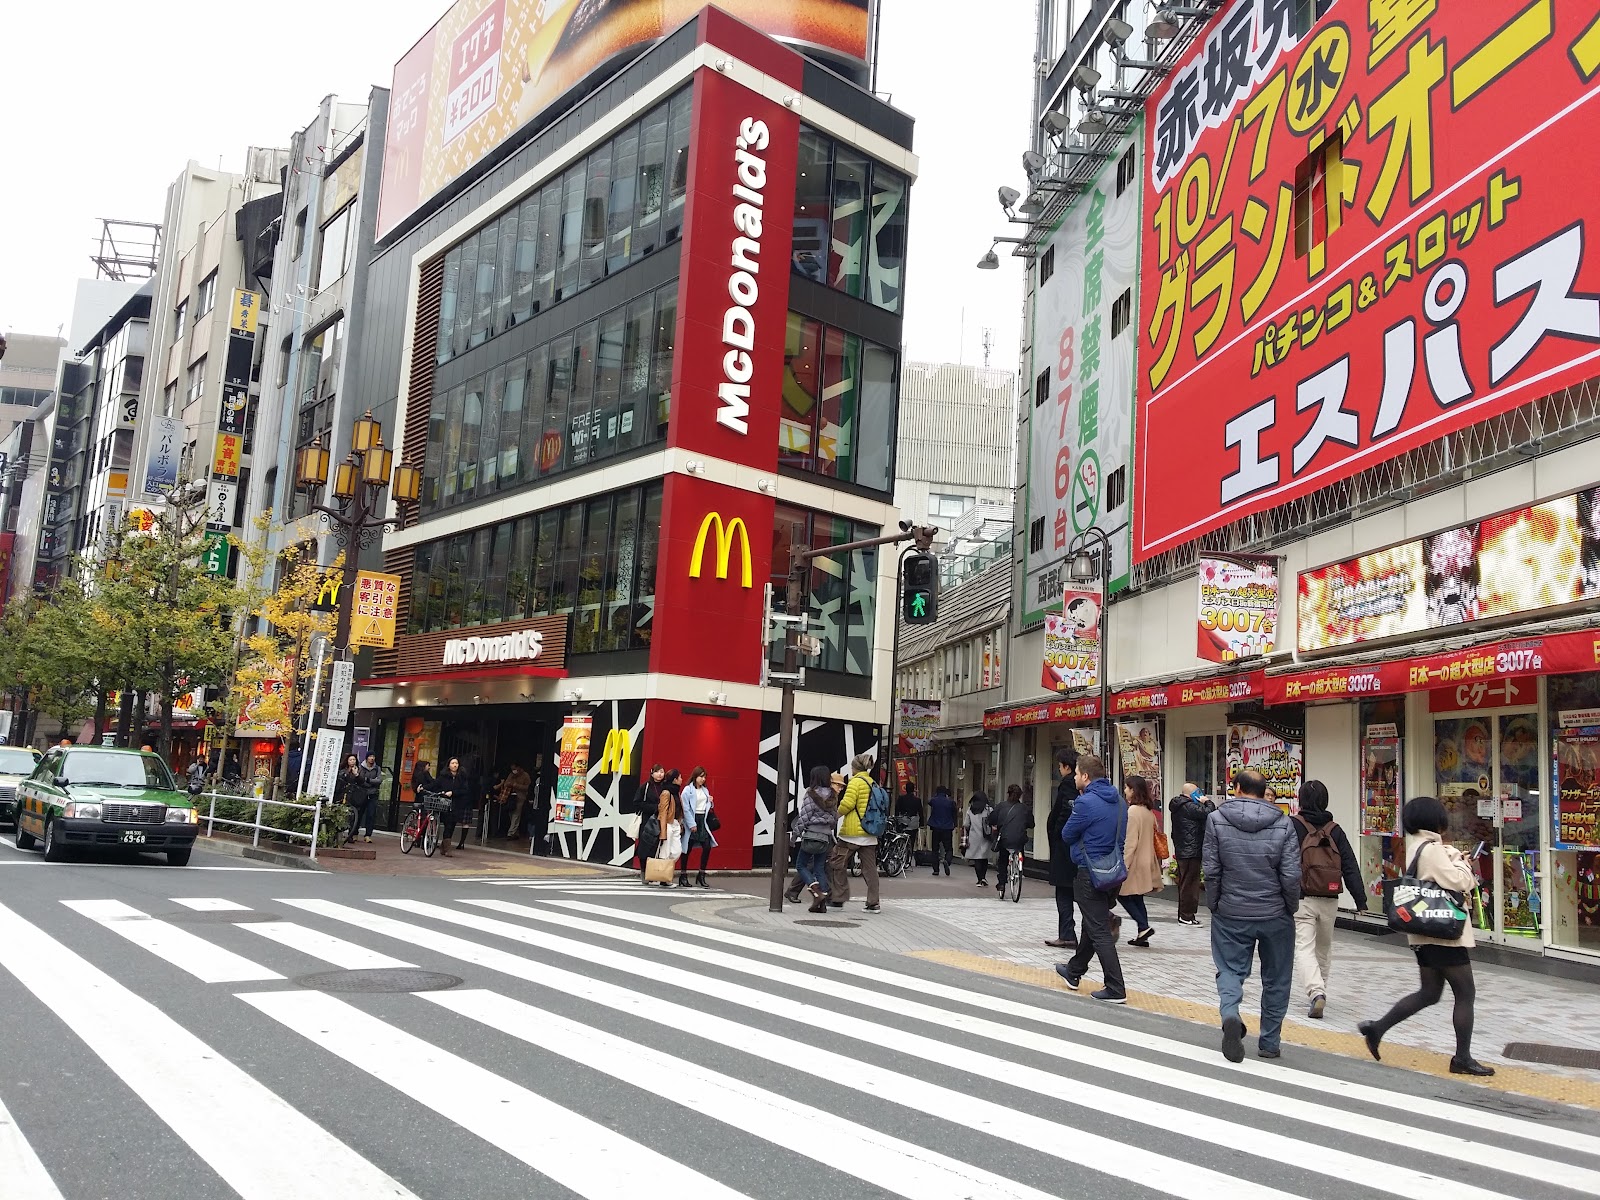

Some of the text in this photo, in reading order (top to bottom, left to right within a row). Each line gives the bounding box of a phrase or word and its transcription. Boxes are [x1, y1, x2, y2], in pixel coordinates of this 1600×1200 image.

[458, 13, 495, 75] エグチ
[450, 66, 494, 127] ¥200
[1152, 68, 1288, 270] 10/7
[716, 116, 770, 435] McDonald's
[1220, 220, 1600, 506] エスパス
[572, 409, 601, 430] FREE
[571, 425, 600, 446] Wi-Fi
[157, 434, 173, 478] バルボラ
[359, 591, 394, 606] 客引き
[360, 578, 396, 592] 悪質な
[358, 604, 394, 619] に注意
[1200, 606, 1273, 634] 3007台
[442, 629, 543, 665] McDonald's
[1409, 649, 1543, 686] 日本一の超大型店 3007台
[1286, 674, 1381, 698] 日本一の超大型店 3007台
[1456, 678, 1519, 707] Cゲート
[1421, 887, 1441, 898] GIVE
